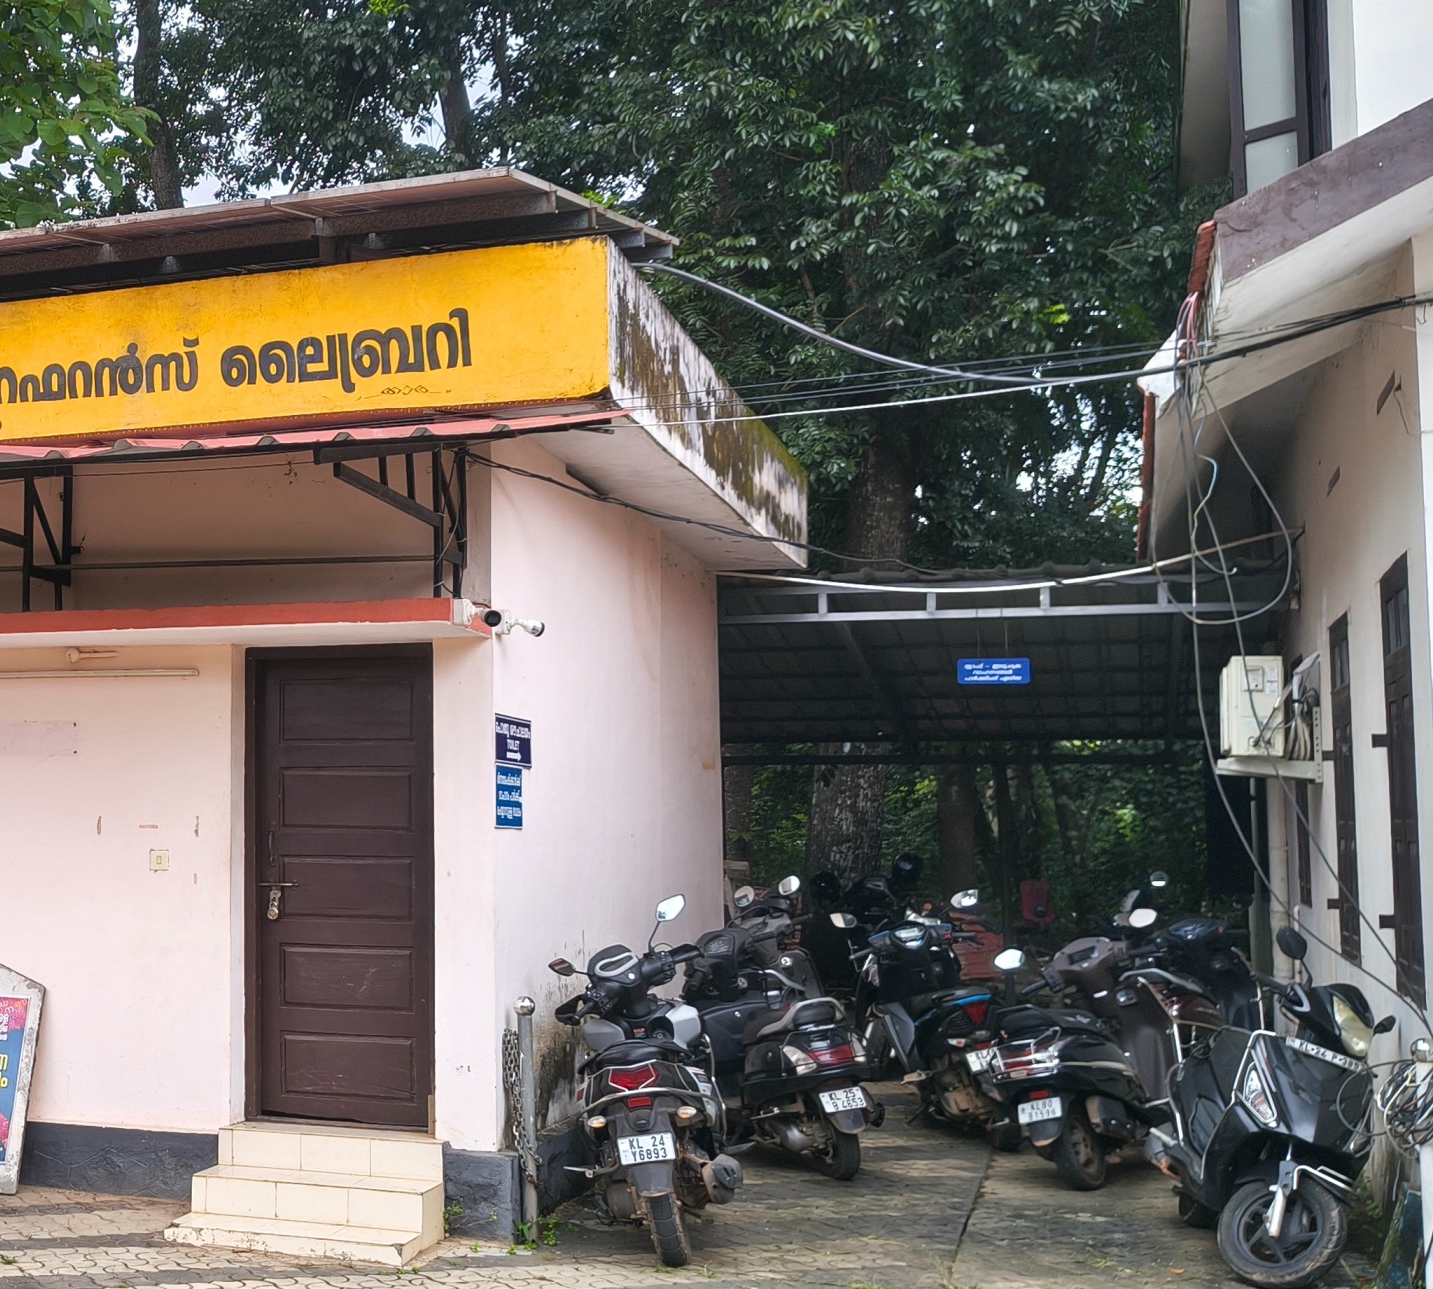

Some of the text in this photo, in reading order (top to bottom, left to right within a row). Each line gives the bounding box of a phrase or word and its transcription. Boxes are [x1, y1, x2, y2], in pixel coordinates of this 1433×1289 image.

[220, 306, 473, 394] ലൈബ്രറി
[843, 1088, 856, 1099] 25
[628, 1135, 665, 1150] KL 24
[631, 1147, 667, 1162] Y6893
